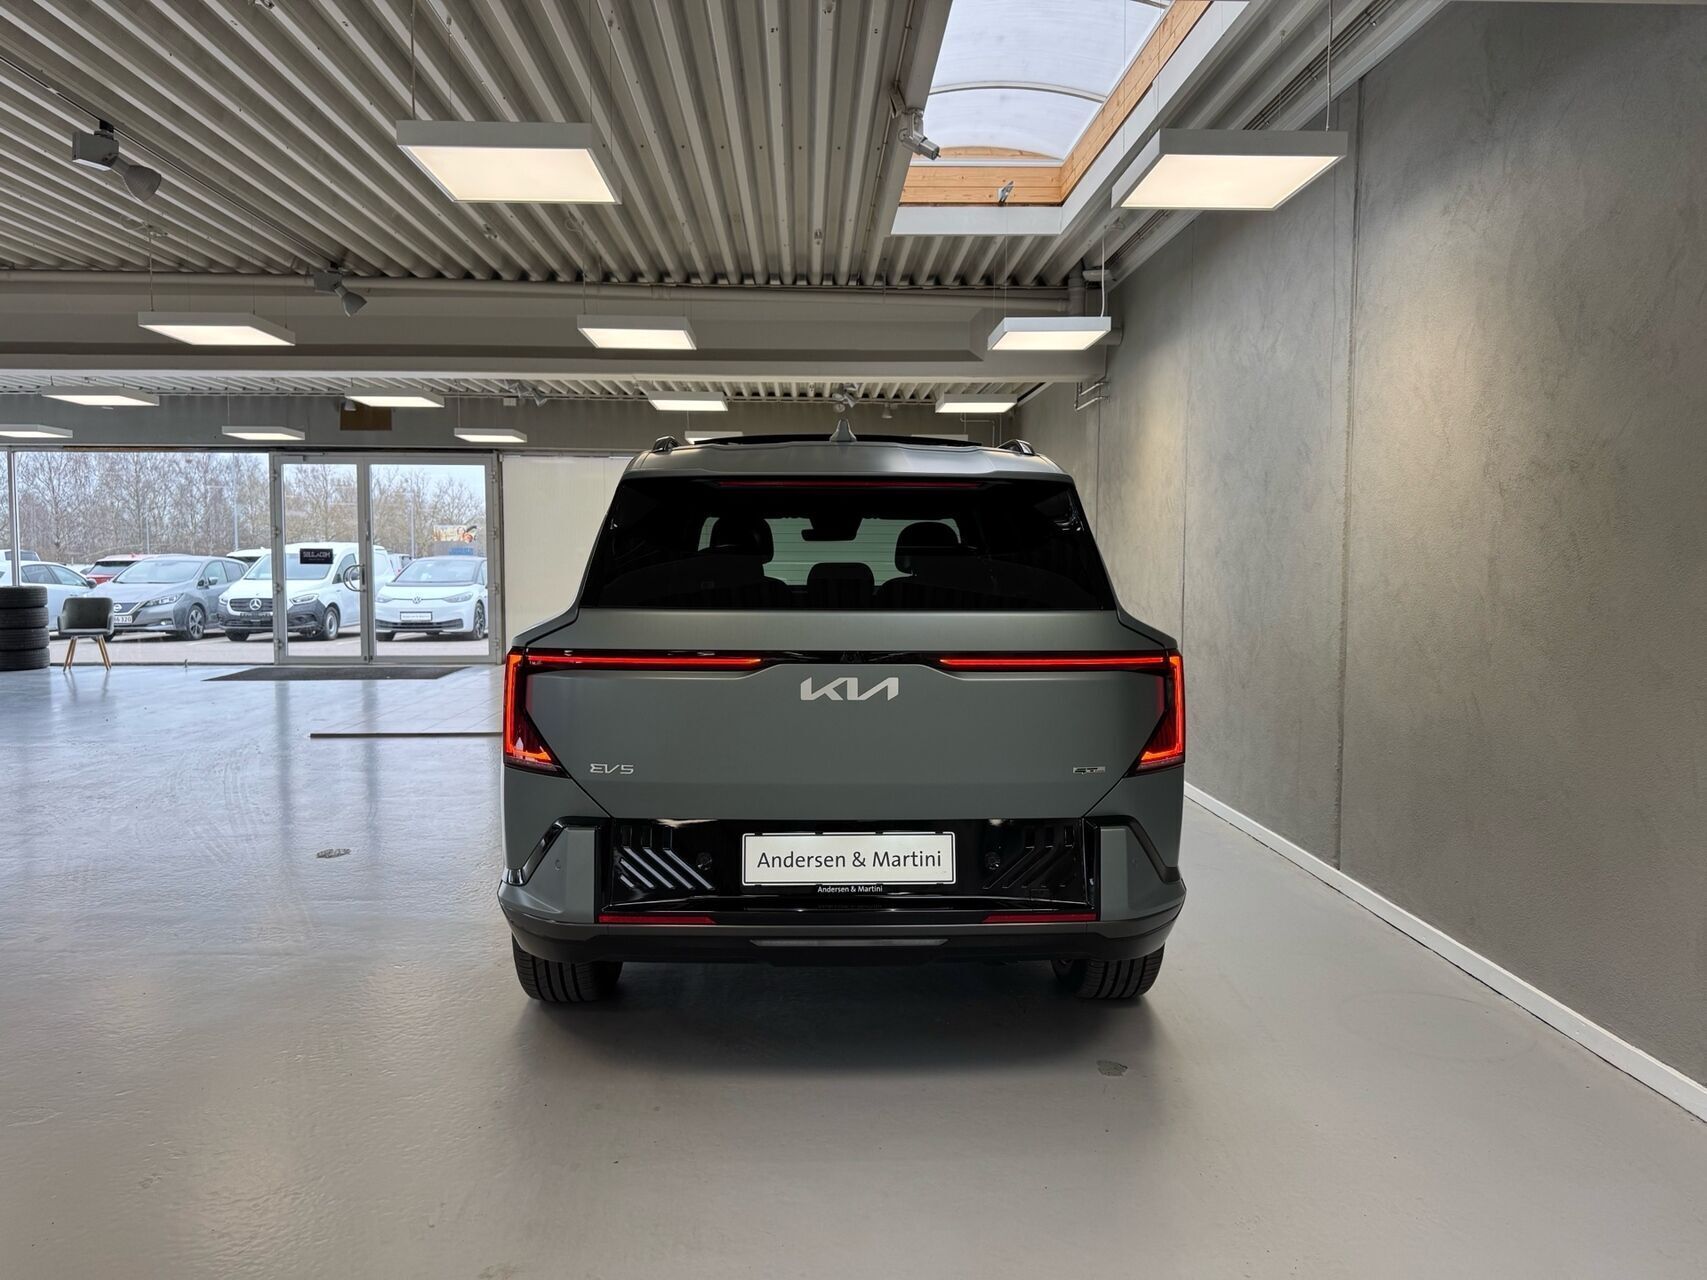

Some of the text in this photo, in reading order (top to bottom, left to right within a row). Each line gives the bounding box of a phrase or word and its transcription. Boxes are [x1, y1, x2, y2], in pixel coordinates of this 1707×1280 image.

[800, 677, 899, 701] KIA
[590, 763, 634, 775] EV5
[757, 850, 942, 869] Andersen & Martini
[857, 885, 883, 893] Martini
